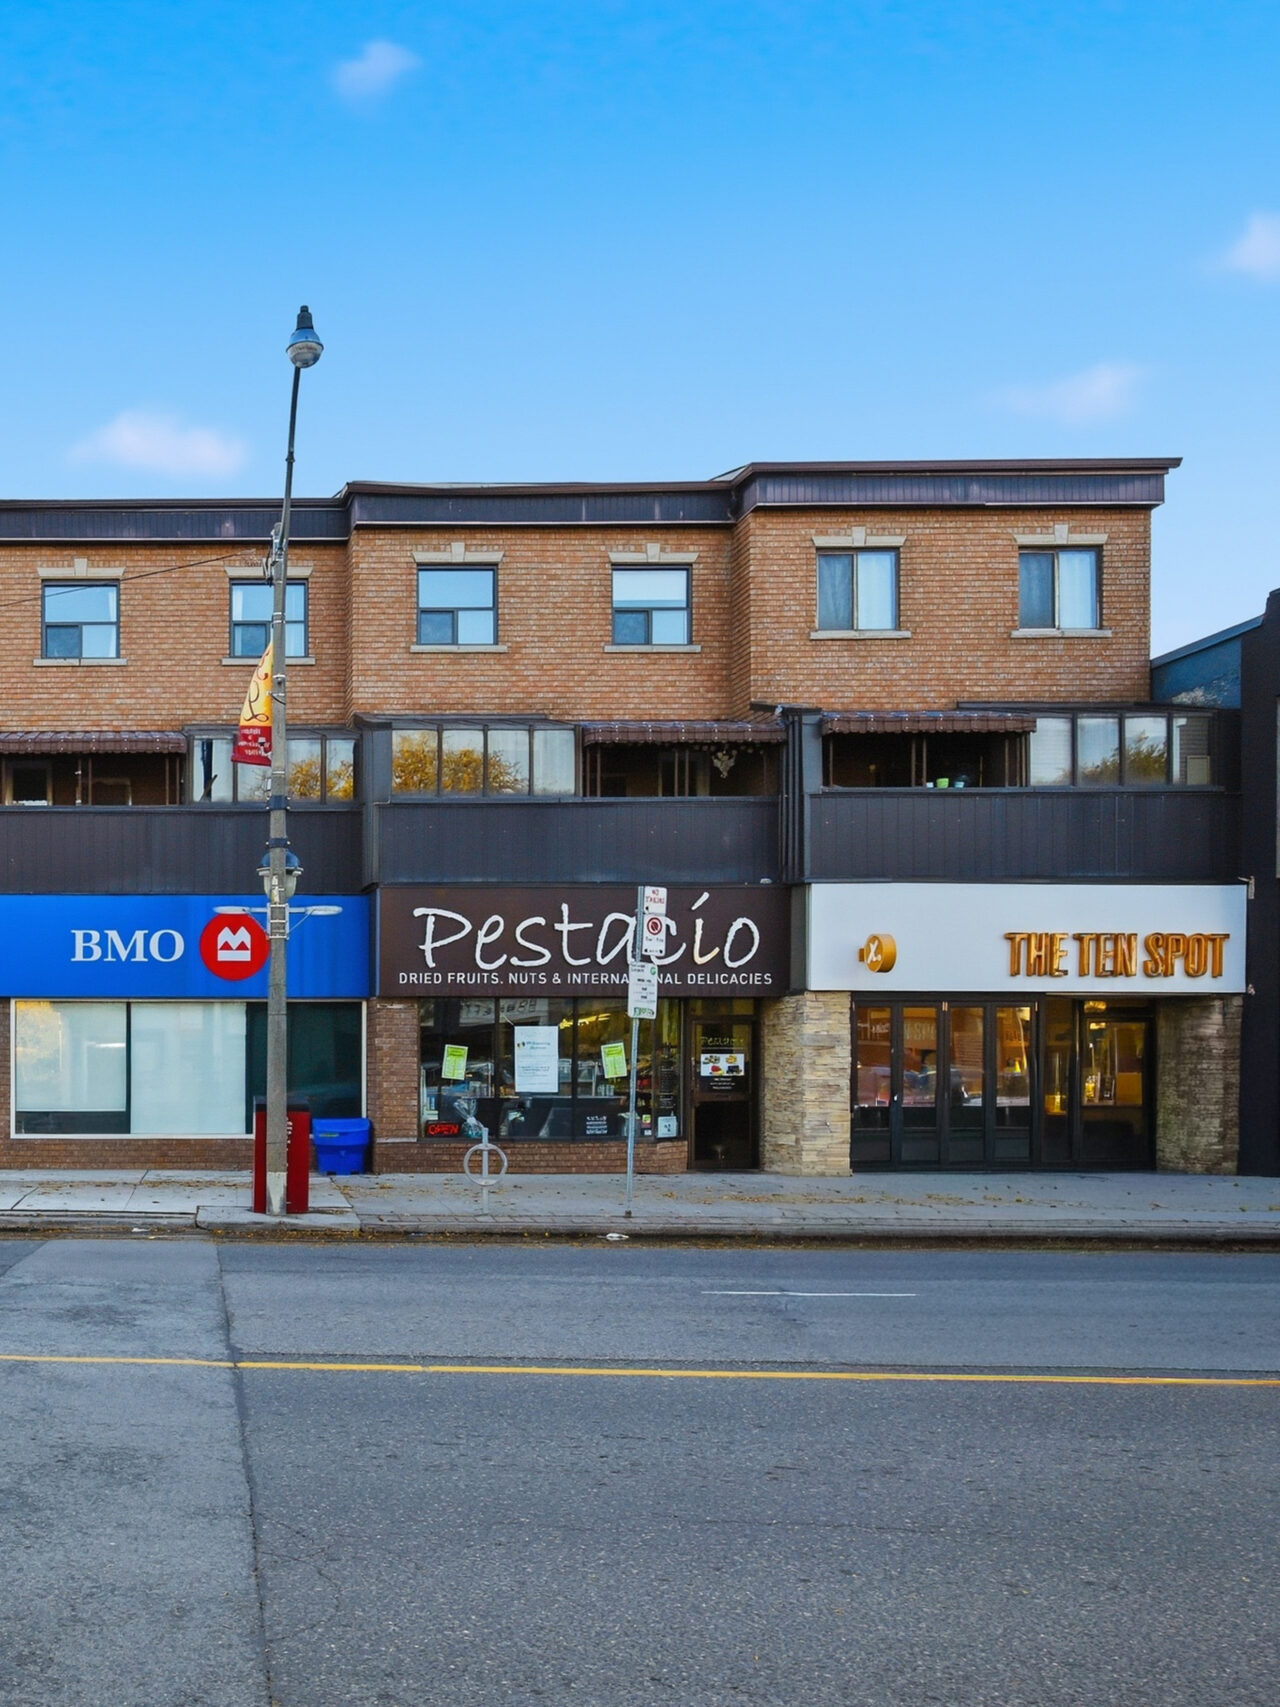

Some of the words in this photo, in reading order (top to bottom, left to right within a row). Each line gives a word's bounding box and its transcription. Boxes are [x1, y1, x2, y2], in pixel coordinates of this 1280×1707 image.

[71, 929, 185, 962] BMO
[1004, 932, 1069, 977] THE
[1072, 932, 1138, 977] TEN
[1143, 932, 1231, 978] SPOT
[399, 972, 442, 984] DRIED
[509, 972, 547, 984] NUTS
[552, 973, 562, 984] &
[567, 973, 682, 985] INTERNANAL
[687, 973, 773, 985] DELICACIES
[428, 1123, 459, 1136] OPEN
